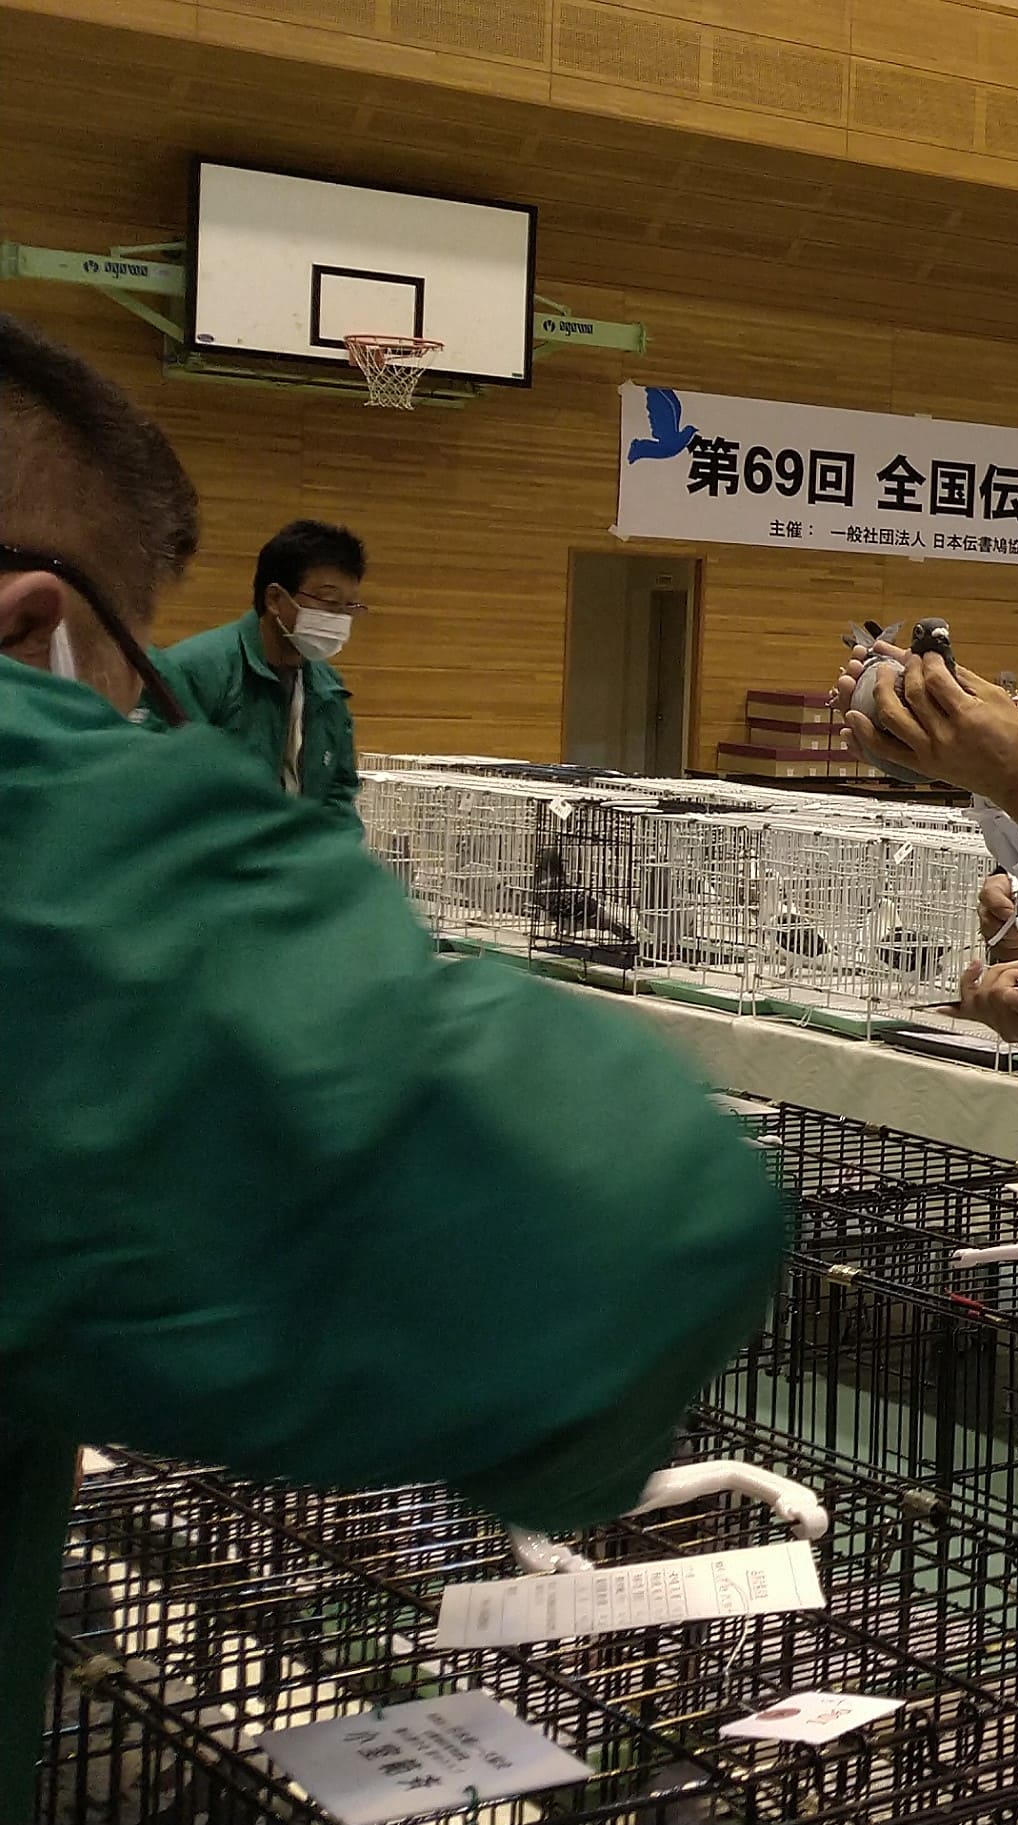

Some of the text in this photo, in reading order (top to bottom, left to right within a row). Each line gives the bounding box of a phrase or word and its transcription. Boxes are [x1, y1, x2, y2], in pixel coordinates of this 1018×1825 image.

[685, 435, 856, 508] 第69回
[830, 526, 927, 549] 一般社団法人
